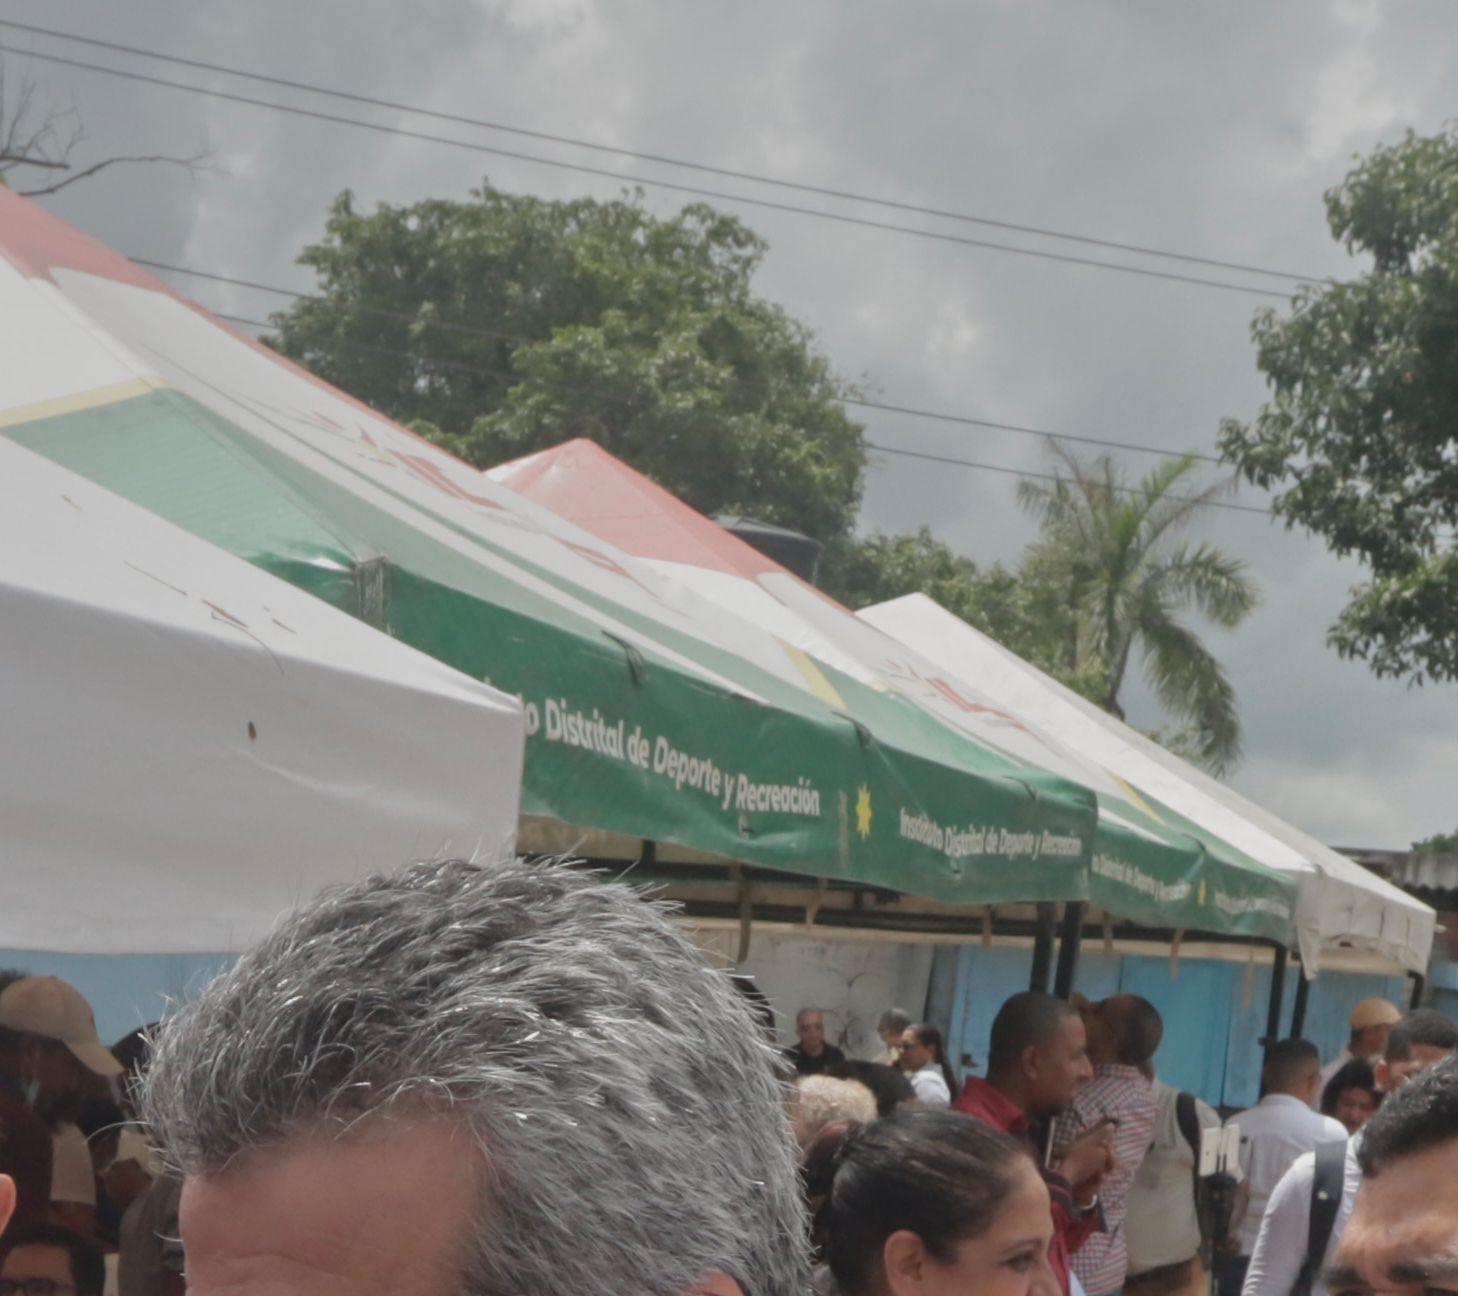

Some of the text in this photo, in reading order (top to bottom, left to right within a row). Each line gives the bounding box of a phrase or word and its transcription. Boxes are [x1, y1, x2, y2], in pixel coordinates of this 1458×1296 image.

[545, 699, 625, 760] Distrital
[627, 726, 649, 769] de
[654, 736, 722, 797] Deporte
[723, 773, 735, 811] y
[736, 773, 821, 817] Recreación
